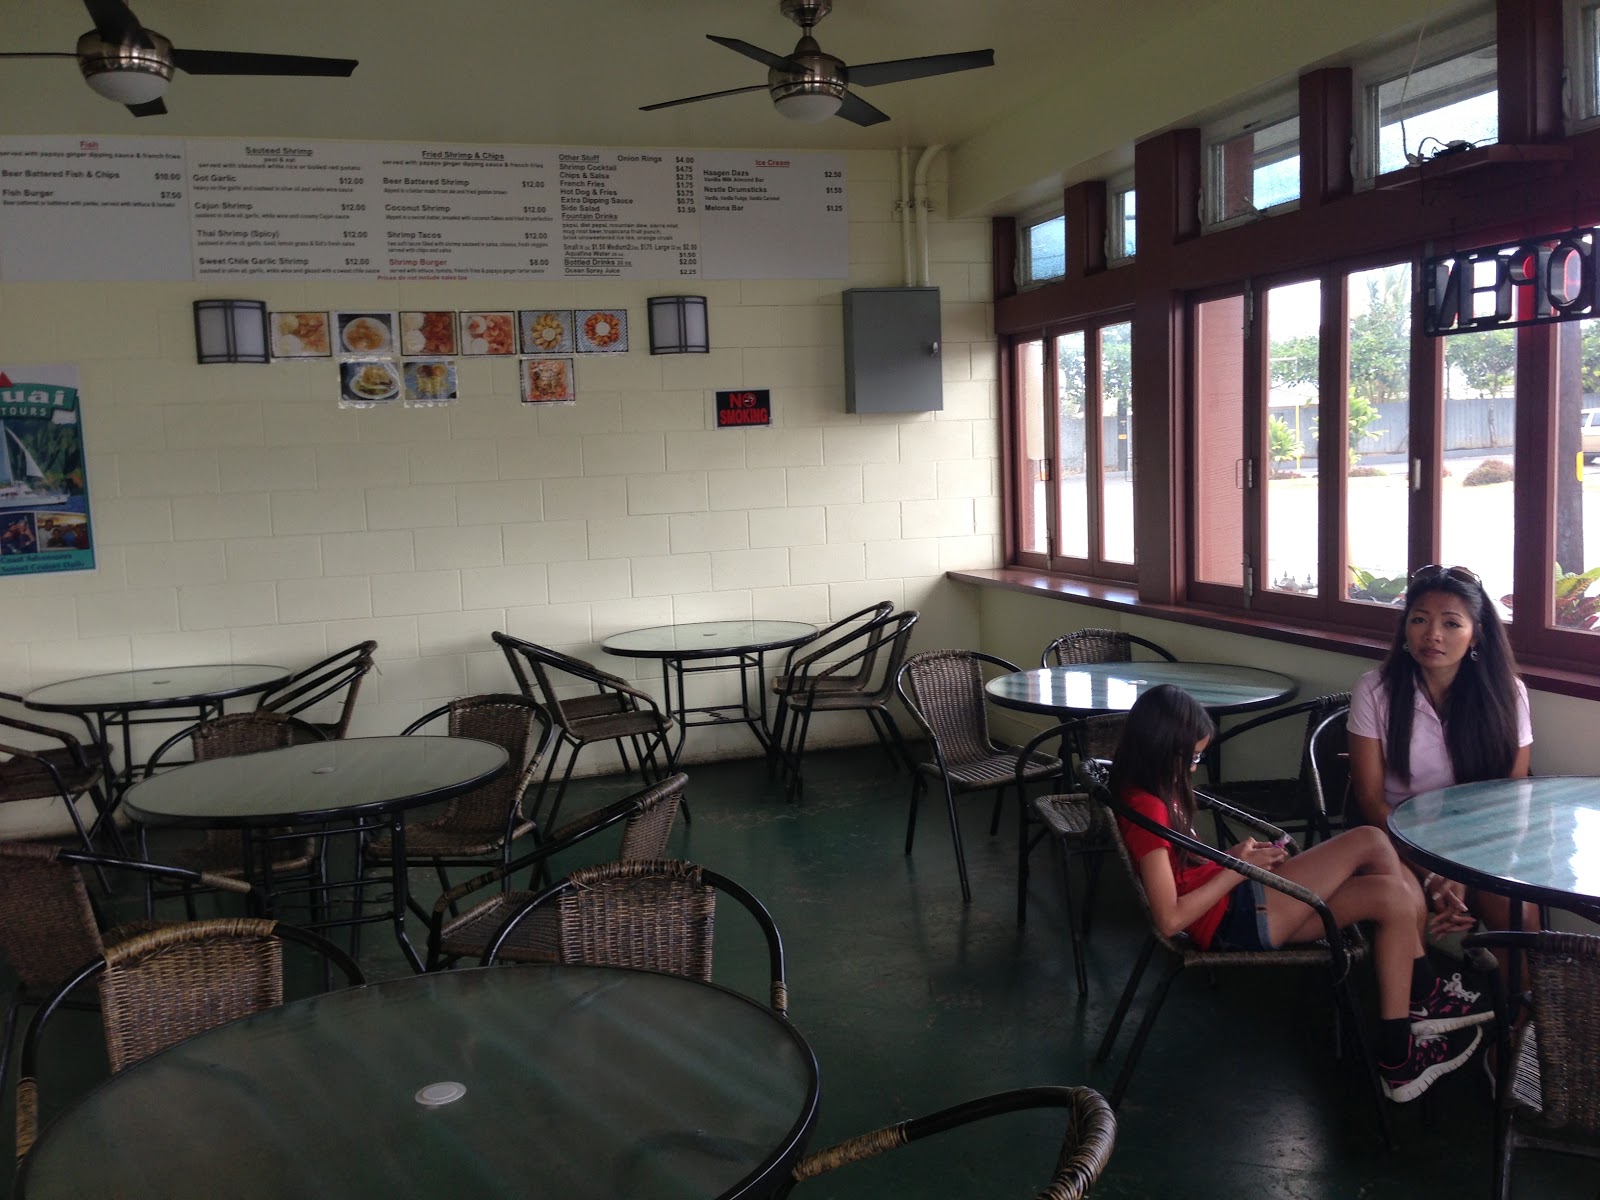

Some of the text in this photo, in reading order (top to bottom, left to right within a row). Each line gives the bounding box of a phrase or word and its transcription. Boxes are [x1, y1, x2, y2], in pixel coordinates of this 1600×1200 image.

[282, 148, 312, 156] Shrimp
[95, 171, 120, 179] Chips
[24, 190, 54, 198] Burger
[194, 202, 219, 210] Cajun
[250, 230, 280, 239] (Spicy)
[729, 392, 756, 408] NO
[1, 406, 47, 416] TOURS
[720, 408, 769, 425] SMOKING
